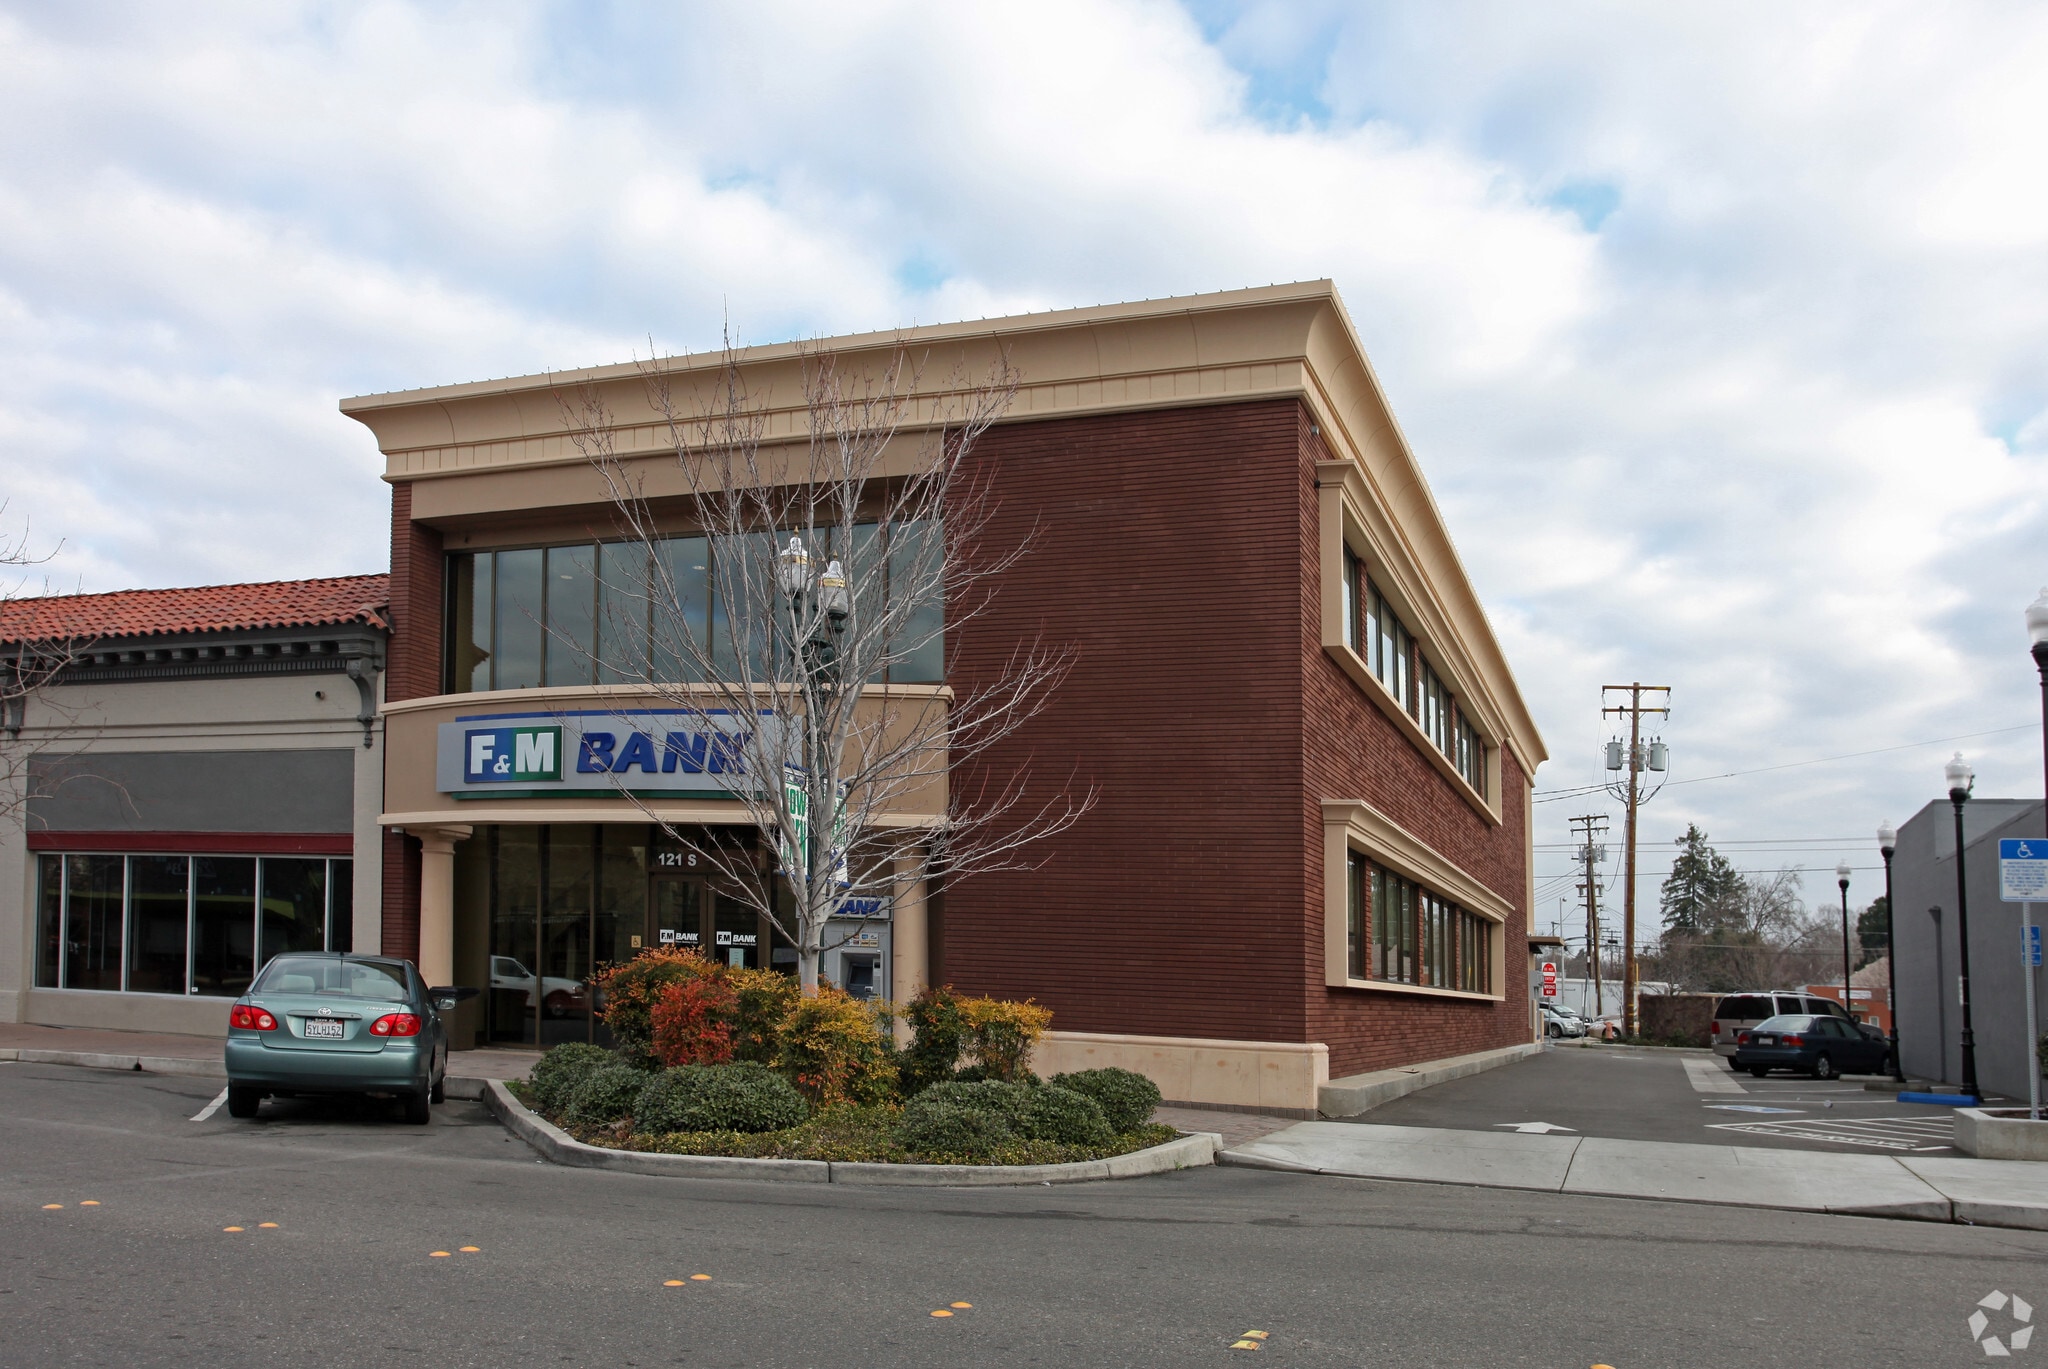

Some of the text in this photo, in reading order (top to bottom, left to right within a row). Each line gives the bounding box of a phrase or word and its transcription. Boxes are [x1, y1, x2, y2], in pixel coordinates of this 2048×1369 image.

[470, 731, 754, 775] F&M BANK
[658, 853, 697, 867] 121 S
[675, 932, 699, 941] BANK
[732, 934, 757, 943] BANK
[307, 1024, 342, 1036] 5YLH152
